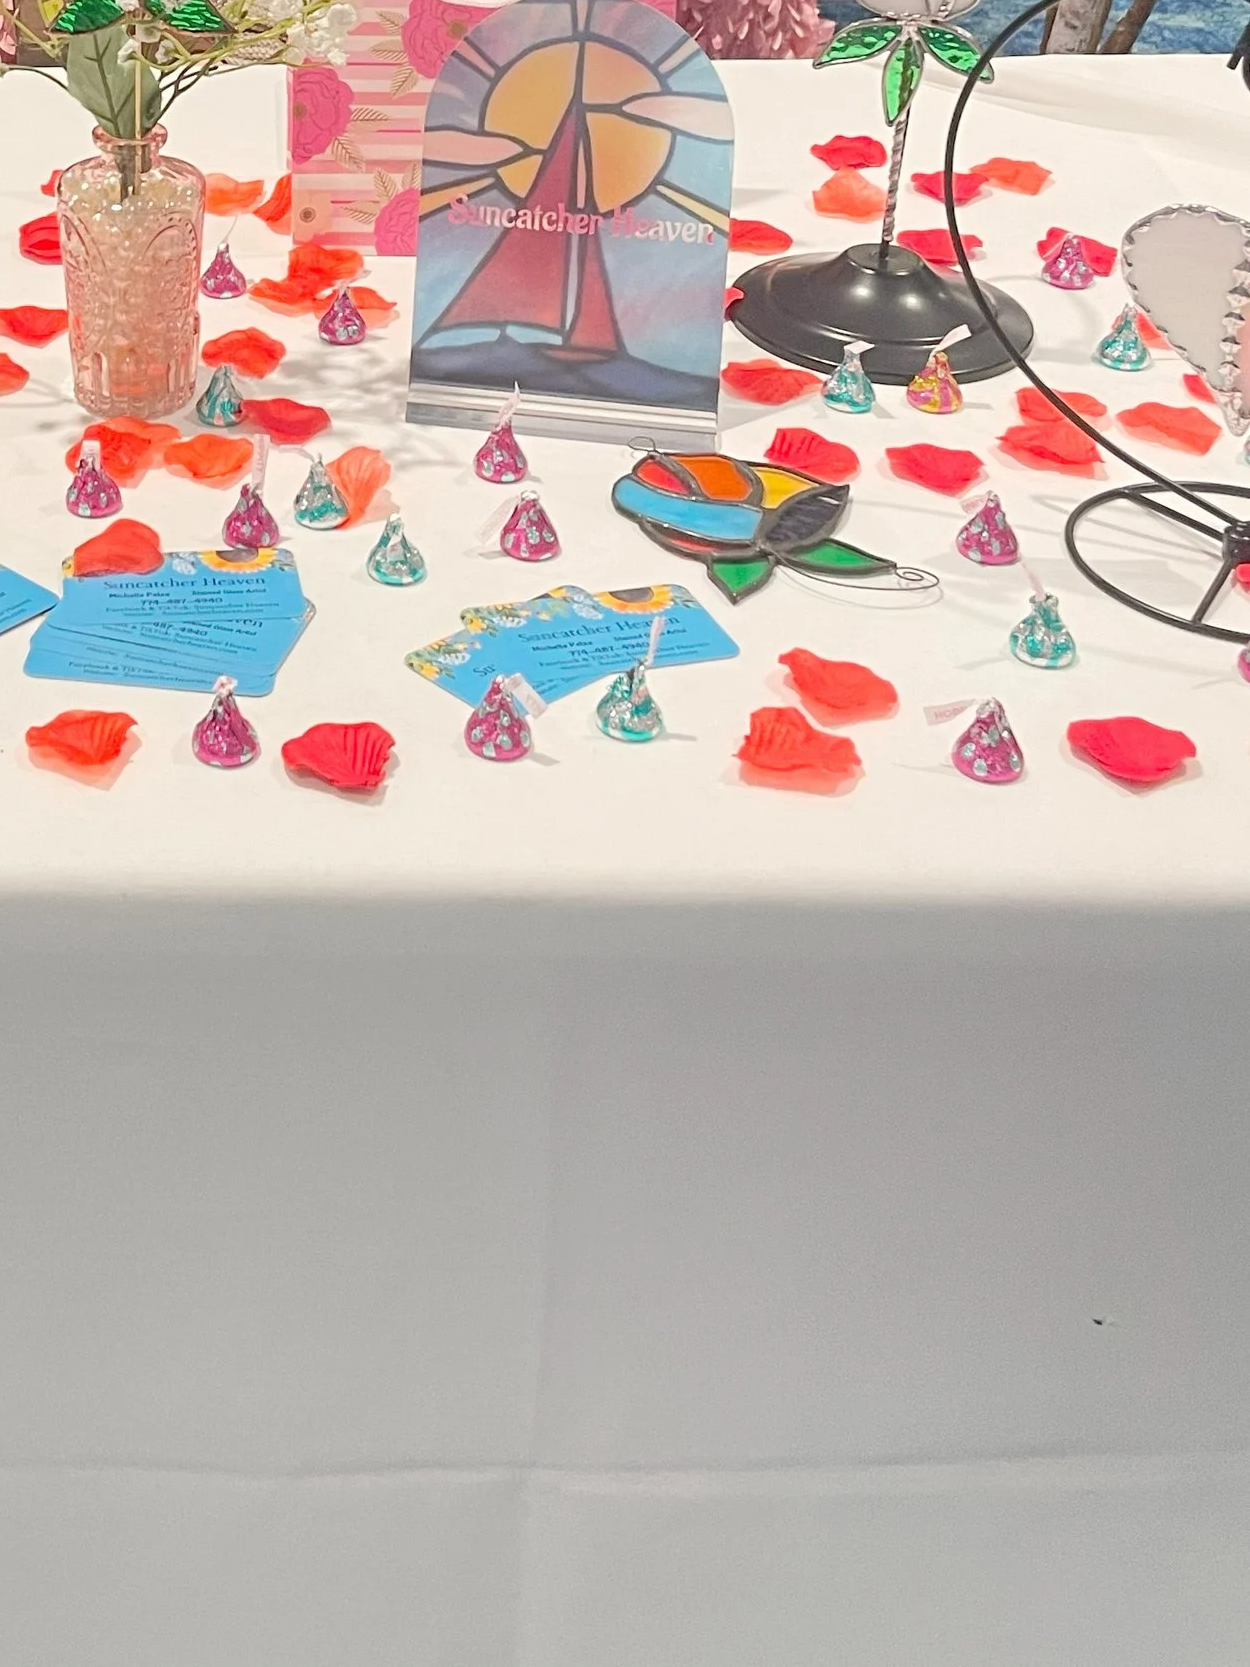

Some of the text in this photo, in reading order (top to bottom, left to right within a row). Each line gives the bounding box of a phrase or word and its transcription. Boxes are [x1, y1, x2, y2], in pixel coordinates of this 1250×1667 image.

[448, 193, 715, 245] Suncatcher Heaven
[102, 577, 266, 590] Suncatcher Heaven
[517, 616, 681, 644] Suncatcher Hean
